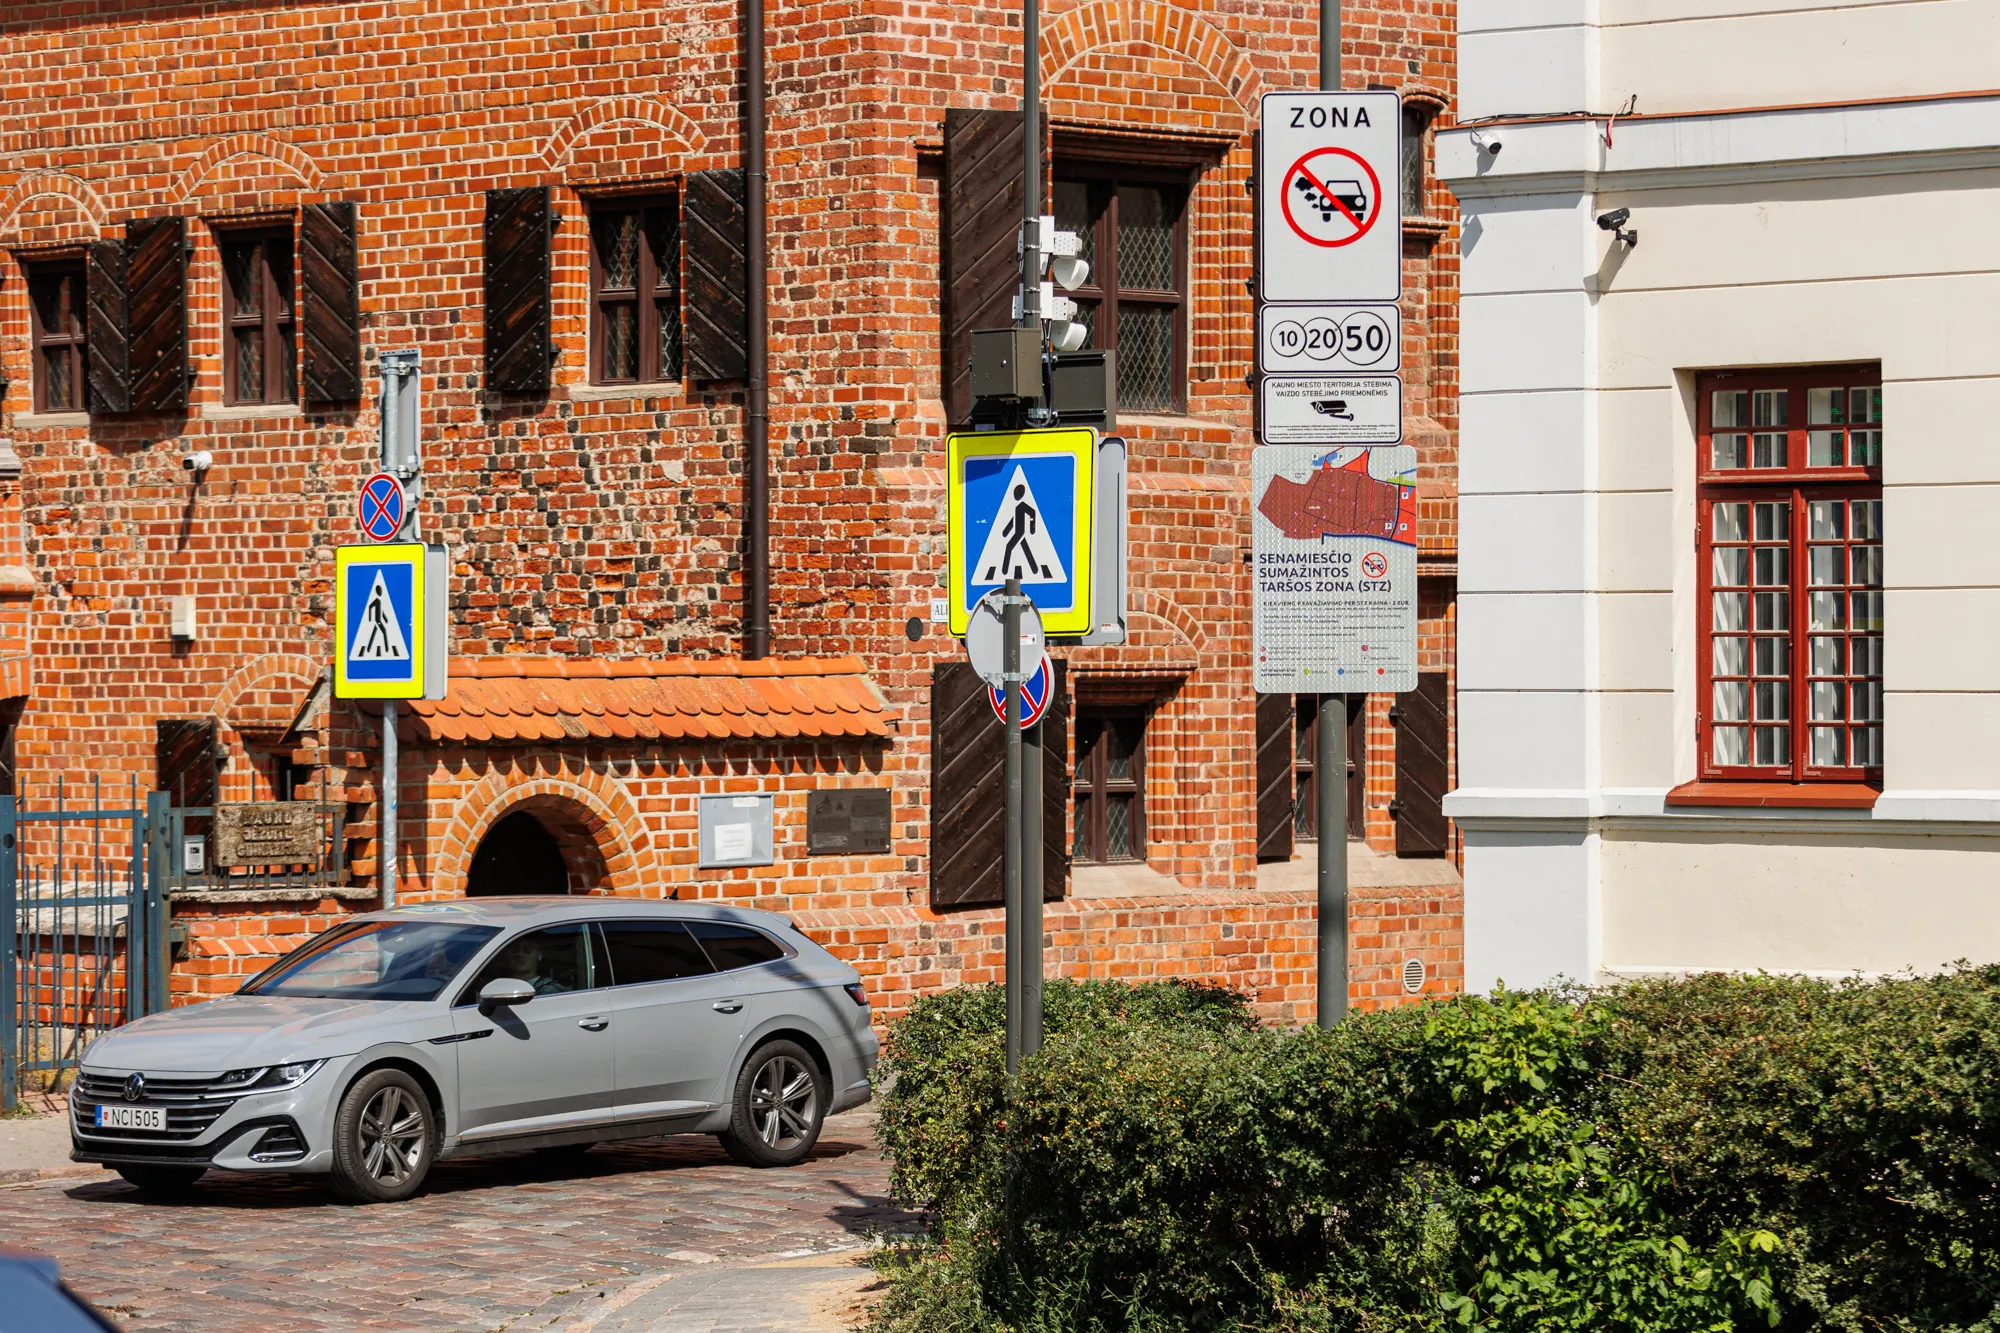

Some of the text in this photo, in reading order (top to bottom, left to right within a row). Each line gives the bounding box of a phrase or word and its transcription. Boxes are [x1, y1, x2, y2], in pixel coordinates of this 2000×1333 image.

[1290, 107, 1371, 128] ZONA
[1278, 325, 1383, 352] 10 20 50
[1260, 550, 1351, 564] SENAMIESČIO
[1260, 565, 1349, 578] SUMAŽINTOS
[1260, 579, 1391, 593] TARŠOS ZONA (STZ)
[112, 1109, 159, 1127] NCI505
